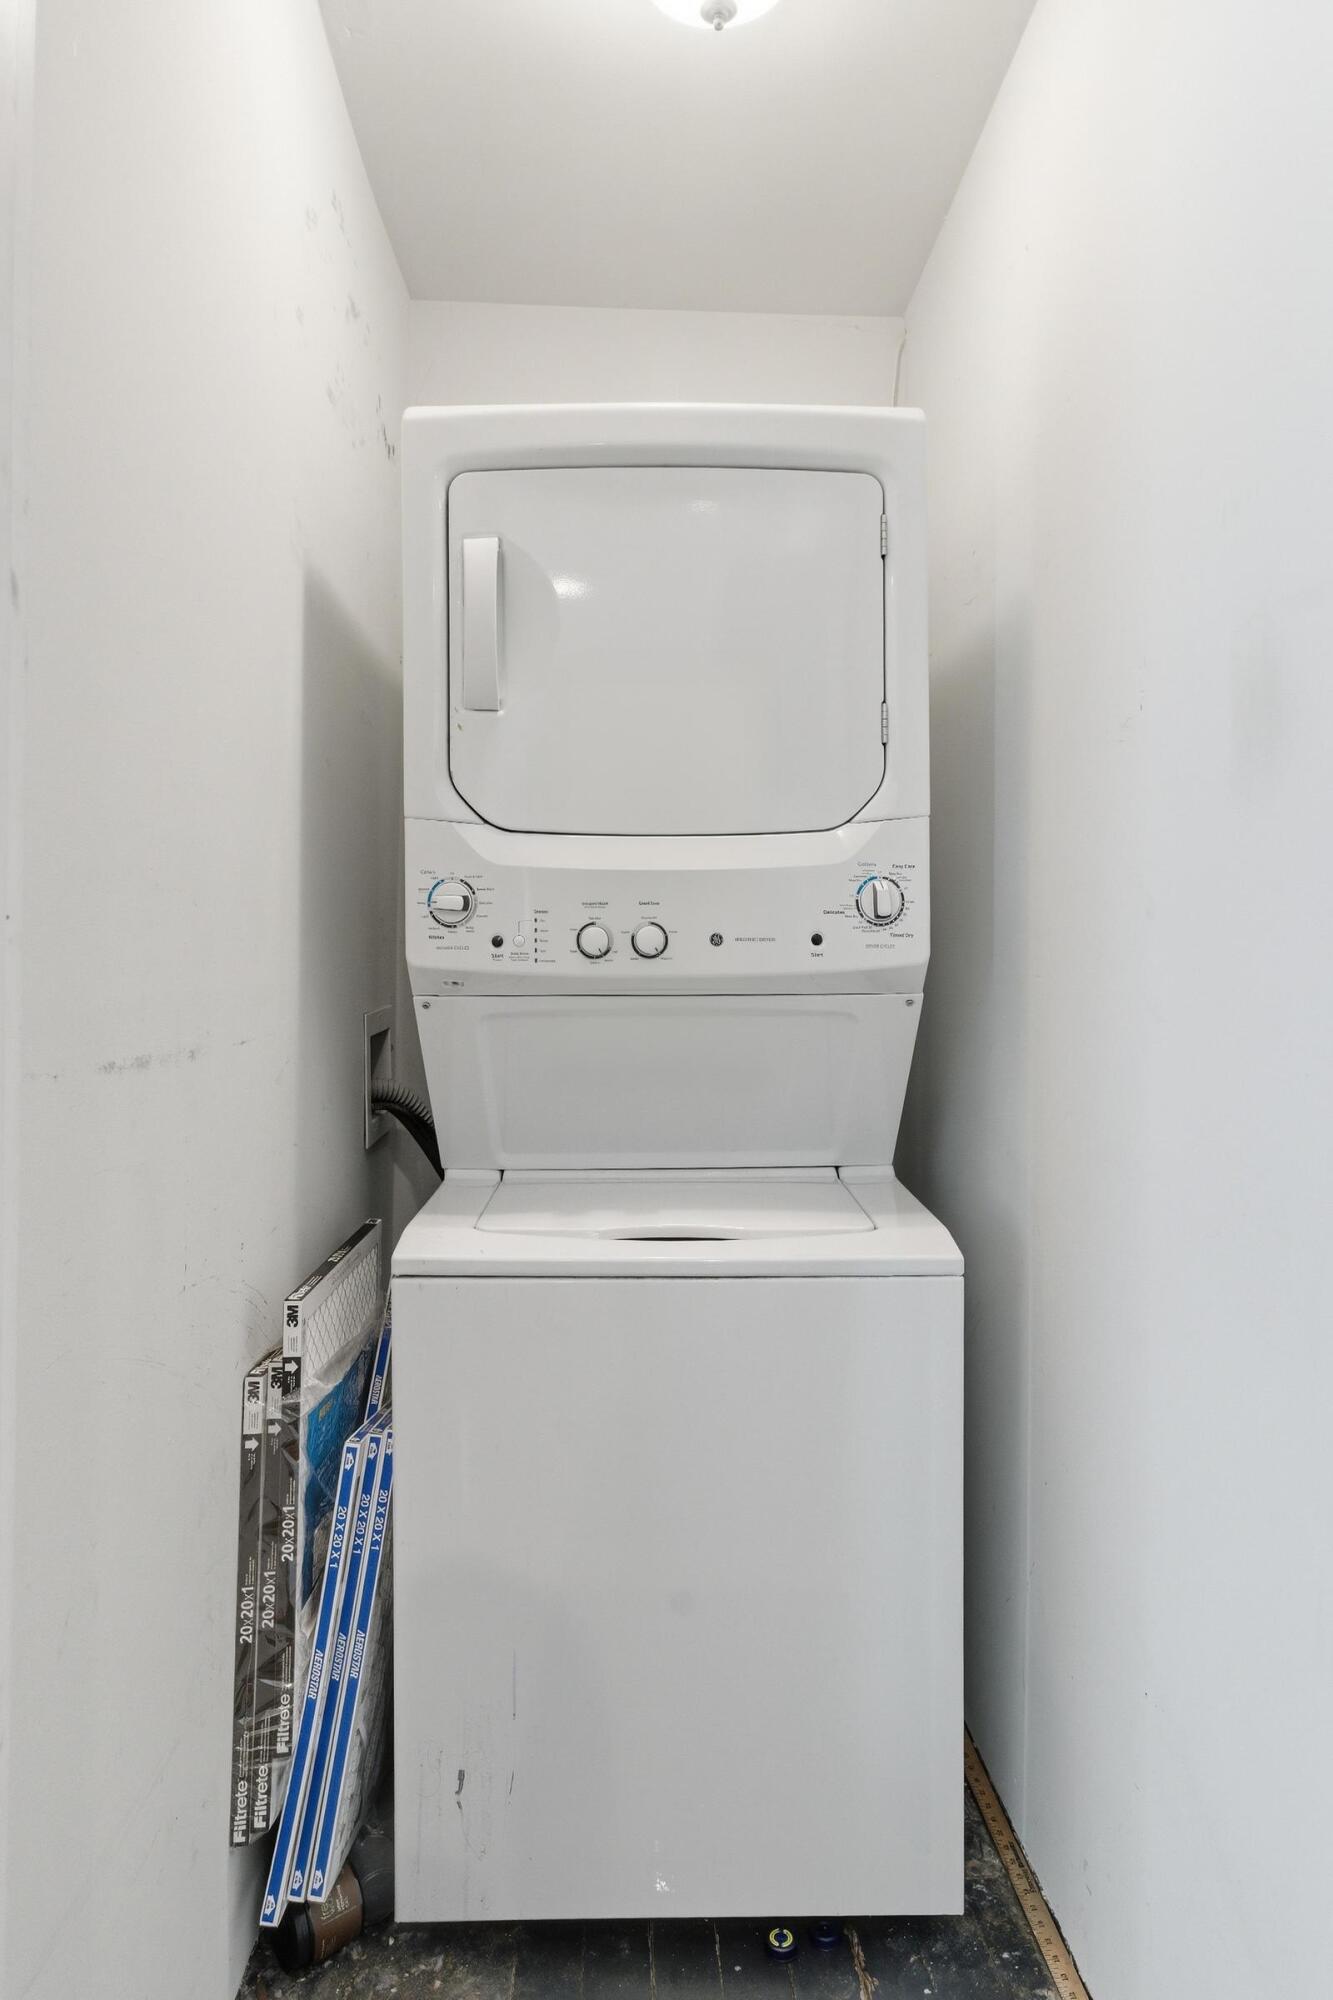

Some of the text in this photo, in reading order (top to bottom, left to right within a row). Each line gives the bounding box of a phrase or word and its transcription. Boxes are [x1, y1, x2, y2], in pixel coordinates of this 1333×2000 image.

[286, 1305, 299, 1328] 3M
[271, 1367, 284, 1389] 3M
[248, 1381, 260, 1405] 3M
[370, 1374, 382, 1405] AEROSTAR
[361, 1494, 371, 1508] 20
[378, 1490, 388, 1503] 20
[337, 1506, 347, 1520] 20
[359, 1509, 368, 1518] X
[377, 1506, 386, 1515] X
[281, 1506, 295, 1562] 20x20x1
[335, 1523, 344, 1532] X
[355, 1521, 366, 1534] 20
[374, 1517, 385, 1531] 20
[333, 1534, 343, 1547] 20
[354, 1537, 363, 1546] X
[372, 1533, 382, 1543] X
[331, 1551, 341, 1560] X
[262, 1571, 276, 1629] 20x20x1
[240, 1586, 254, 1644] 20x20x1
[332, 1632, 347, 1681] AEROSTAR
[350, 1629, 366, 1679] AEROSTAR
[308, 1649, 324, 1700] AEROSTAR
[276, 1694, 291, 1754] Filtrete
[254, 1766, 268, 1828] Filtrete
[233, 1780, 248, 1843] Filtrete
